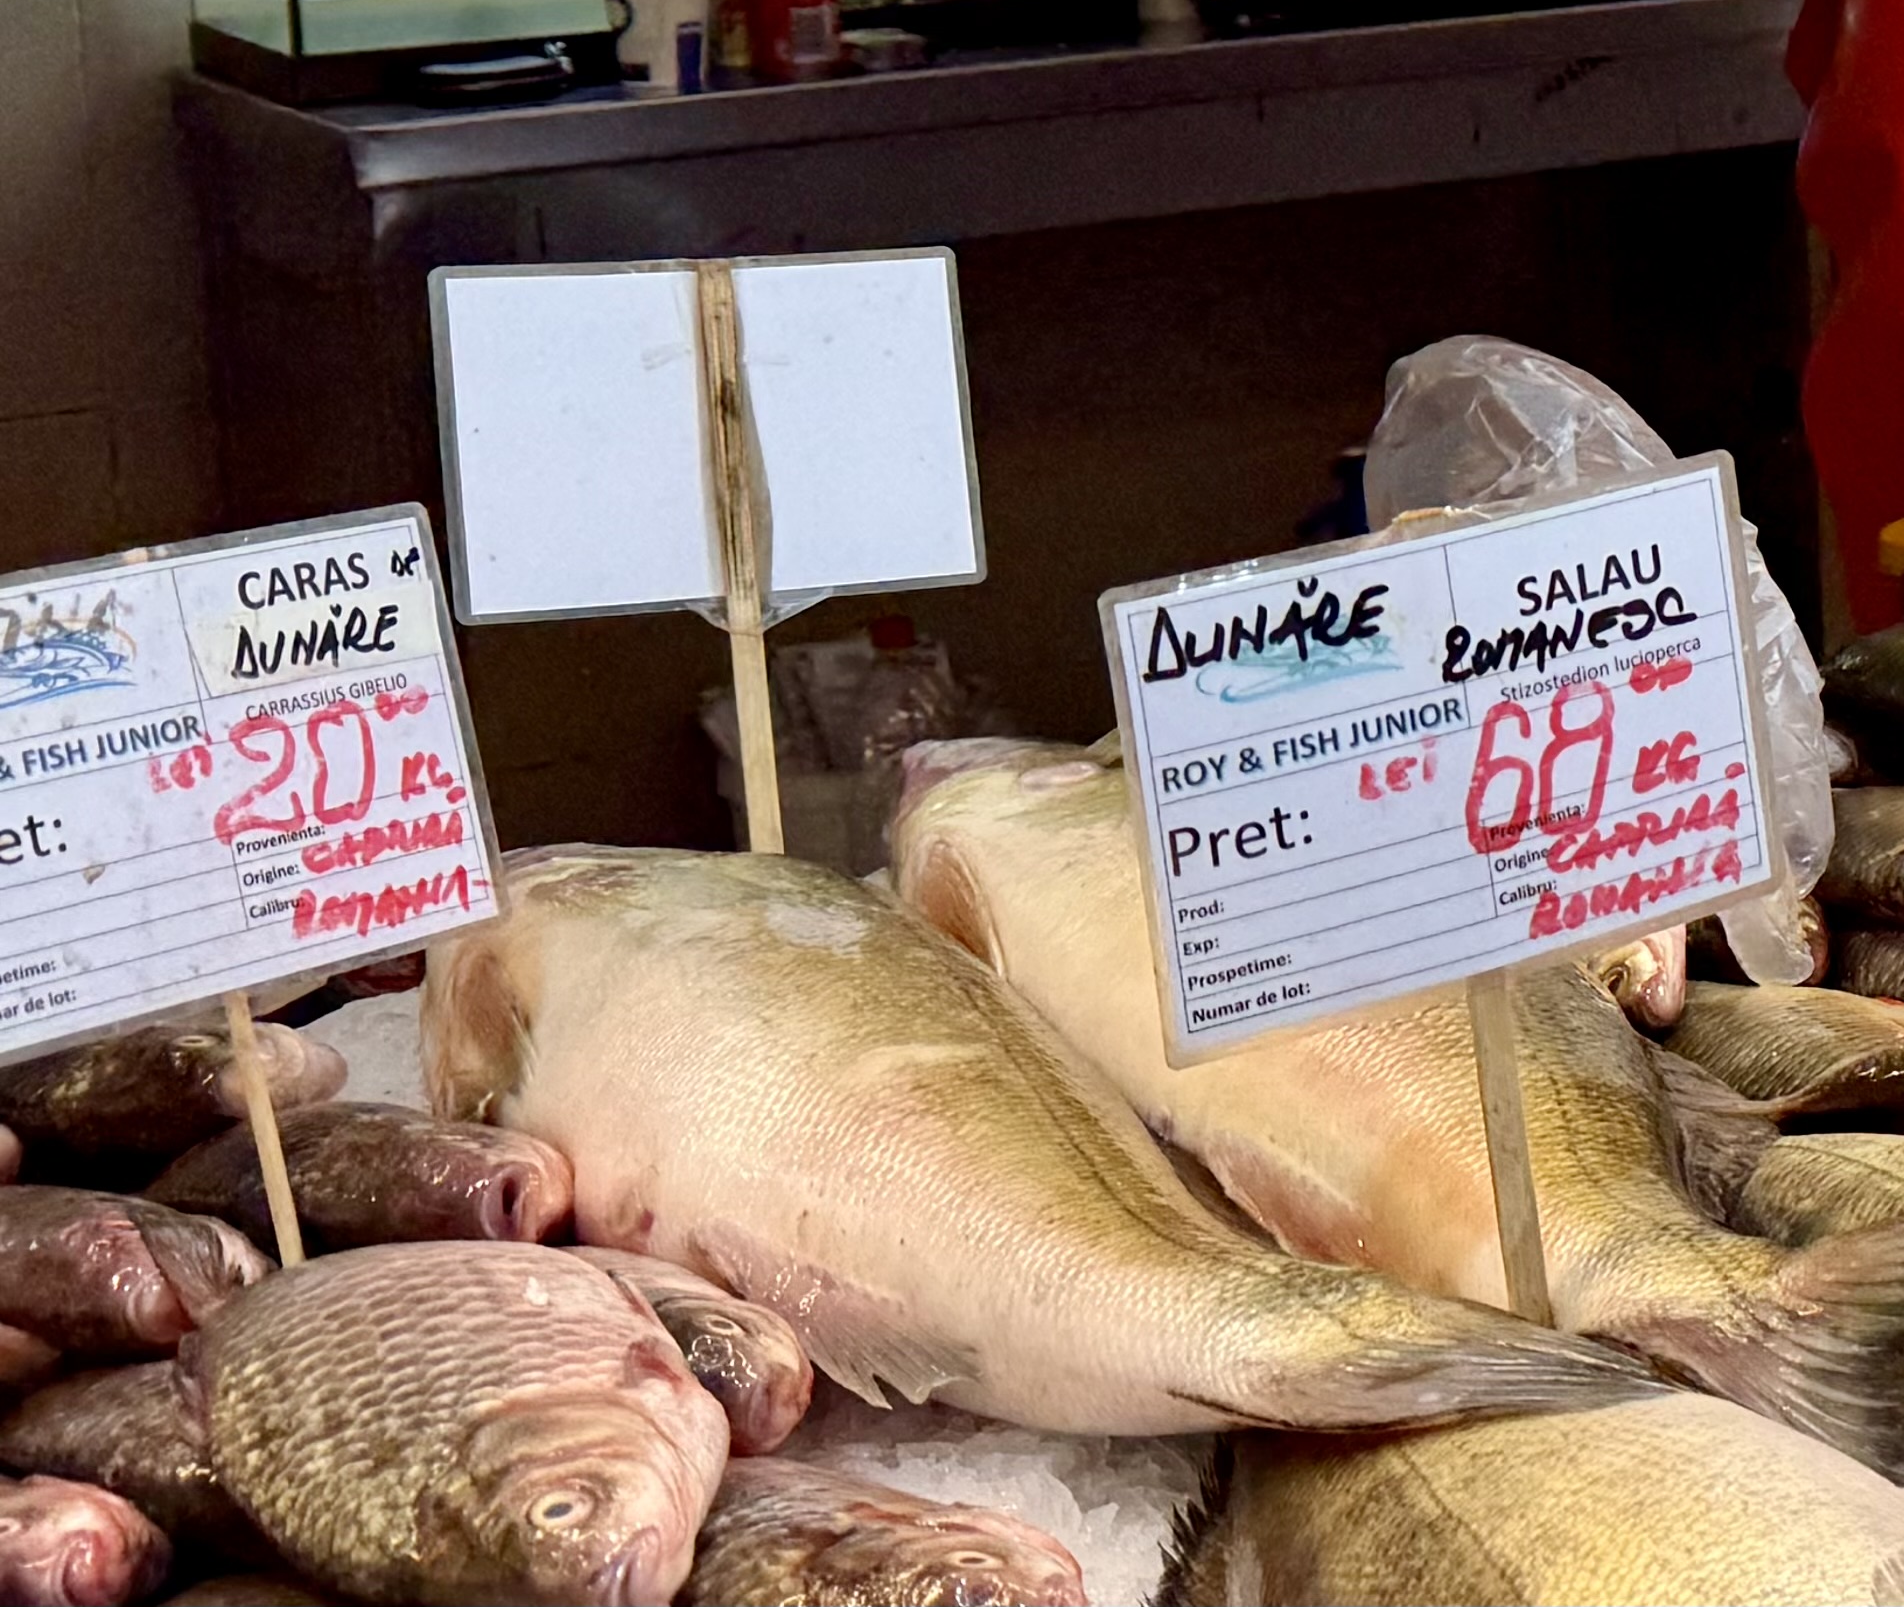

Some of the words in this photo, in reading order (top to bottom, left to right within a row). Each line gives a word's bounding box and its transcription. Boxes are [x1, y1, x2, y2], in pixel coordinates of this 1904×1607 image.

[238, 552, 370, 609] CARAS
[1518, 544, 1663, 617] SALAU
[1500, 663, 1610, 704] Stizostedion
[1614, 635, 1702, 674] lucioperca
[246, 686, 346, 720] CARRASSIUS
[349, 673, 407, 698] GIBELIO
[22, 737, 88, 776] FISH
[95, 715, 201, 760] JUNIOR
[1161, 754, 1228, 793] ROY
[1238, 746, 1265, 774] &
[1272, 728, 1340, 766] FISH
[1347, 699, 1463, 750] JUNIOR
[214, 700, 375, 846] 20
[1465, 681, 1614, 854] 68
[0, 814, 68, 866] et:
[236, 824, 326, 855] Provenienta:
[1167, 806, 1315, 876] Pret:
[1489, 802, 1585, 841] Provenienta:
[242, 864, 300, 887] Origine:
[1494, 846, 1550, 873] Origine
[1178, 899, 1225, 923] Prod:
[1498, 881, 1557, 906] Calibru:
[1183, 937, 1220, 956] Exp:
[0, 958, 57, 987] etime:
[1187, 954, 1292, 991] Prospetime:
[24, 994, 45, 1015] de
[47, 989, 77, 1007] lot:
[1192, 999, 1252, 1024] Numar
[1256, 990, 1277, 1007] de
[1282, 982, 1311, 1000] lot:
